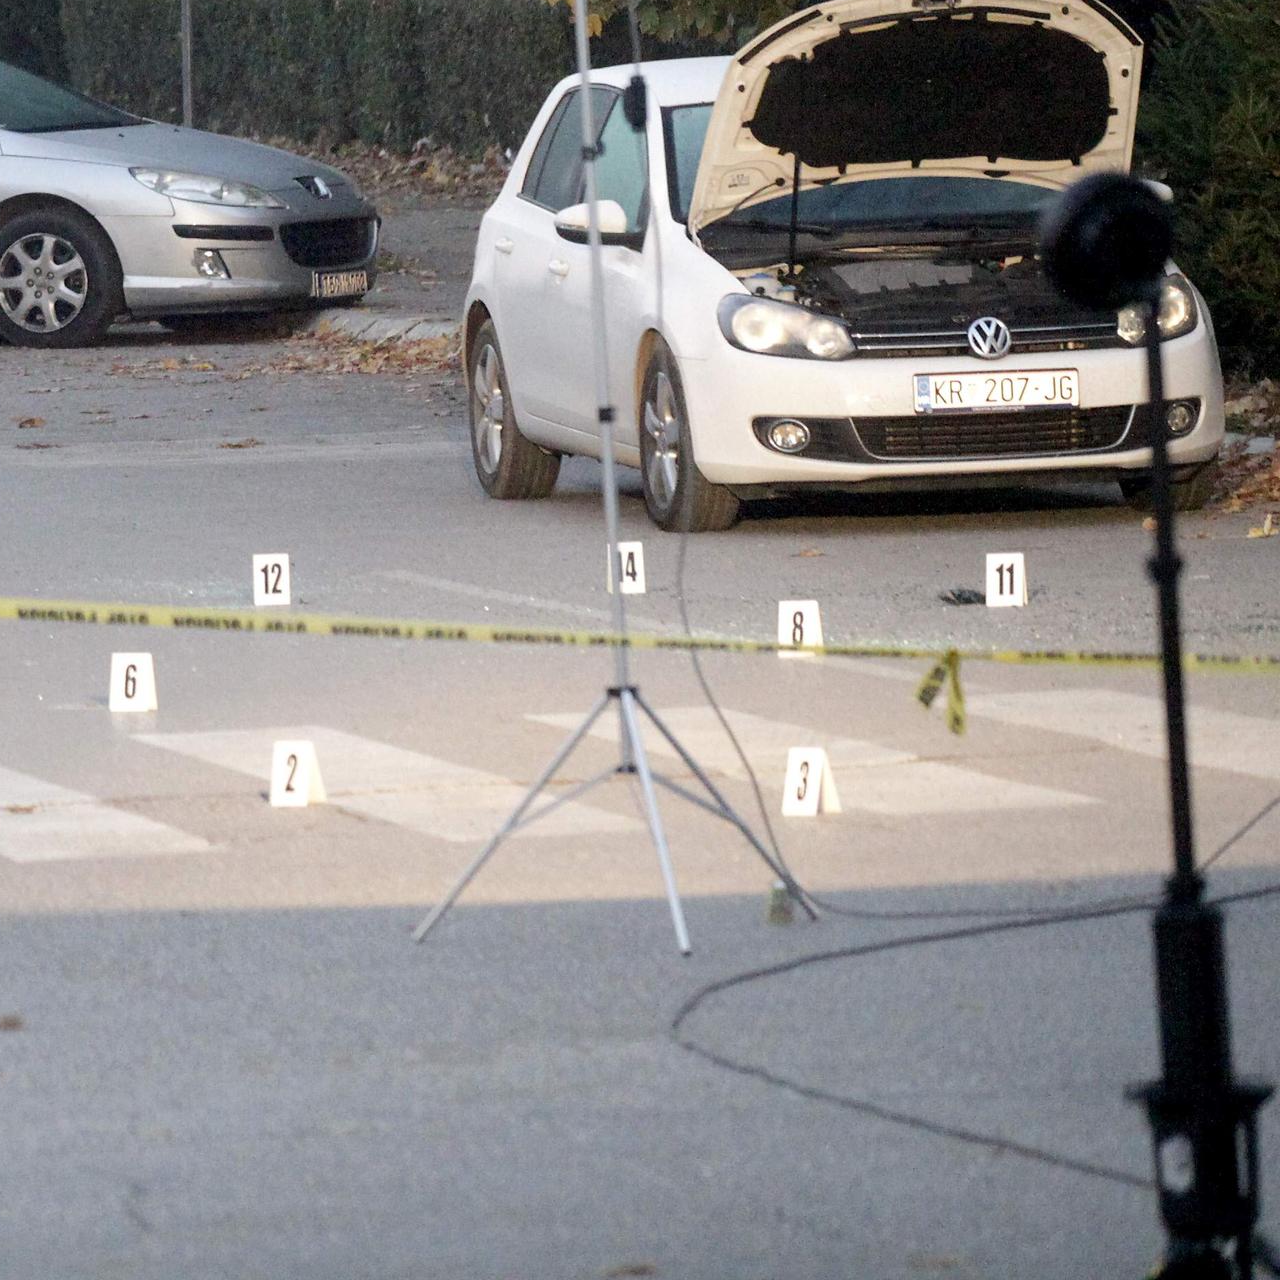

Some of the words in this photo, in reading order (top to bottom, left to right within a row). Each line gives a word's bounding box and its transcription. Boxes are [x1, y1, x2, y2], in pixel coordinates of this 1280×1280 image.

[933, 379, 963, 404] KR
[985, 375, 1073, 402] 207-JG
[261, 563, 283, 595] 12
[995, 563, 1015, 596] 11
[792, 610, 804, 645] 8
[125, 663, 137, 699] 6
[284, 754, 298, 792] 2
[796, 761, 810, 801] 3
